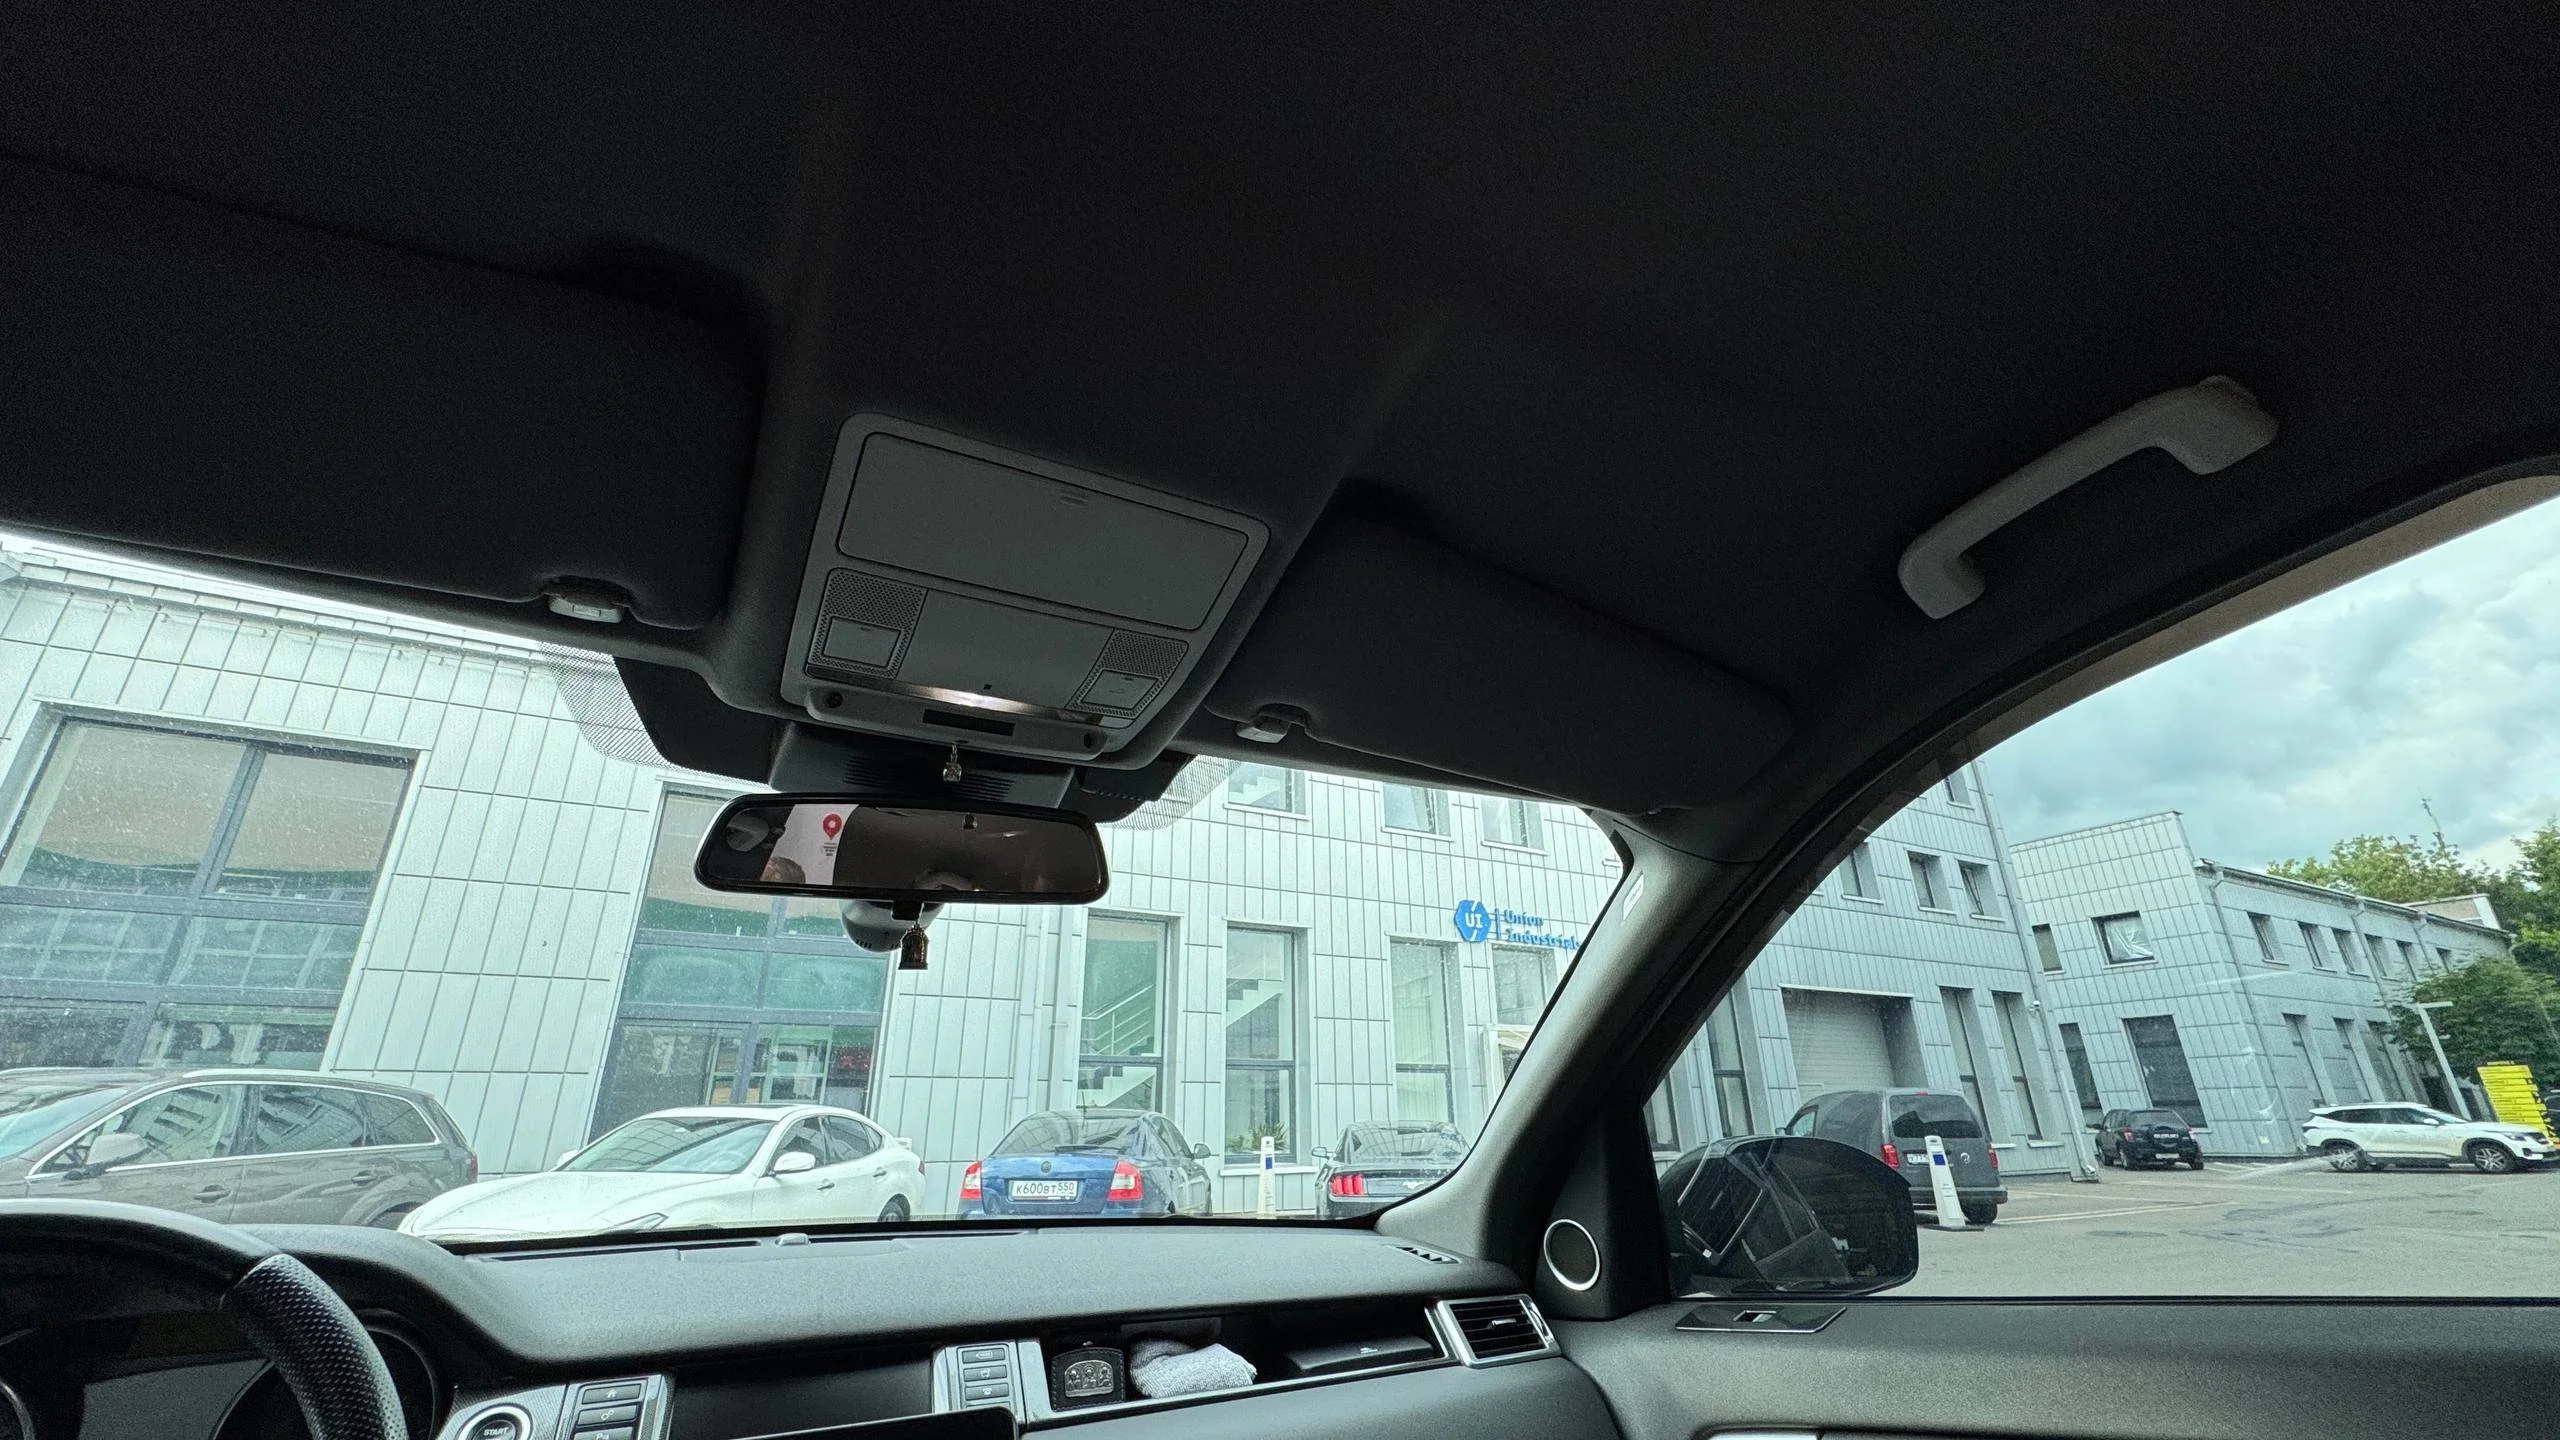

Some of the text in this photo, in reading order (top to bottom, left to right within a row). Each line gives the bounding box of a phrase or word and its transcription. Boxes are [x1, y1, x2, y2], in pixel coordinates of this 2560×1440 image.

[1464, 912, 1483, 929] UI
[1504, 909, 1544, 927] Union
[483, 1426, 509, 1436] START
